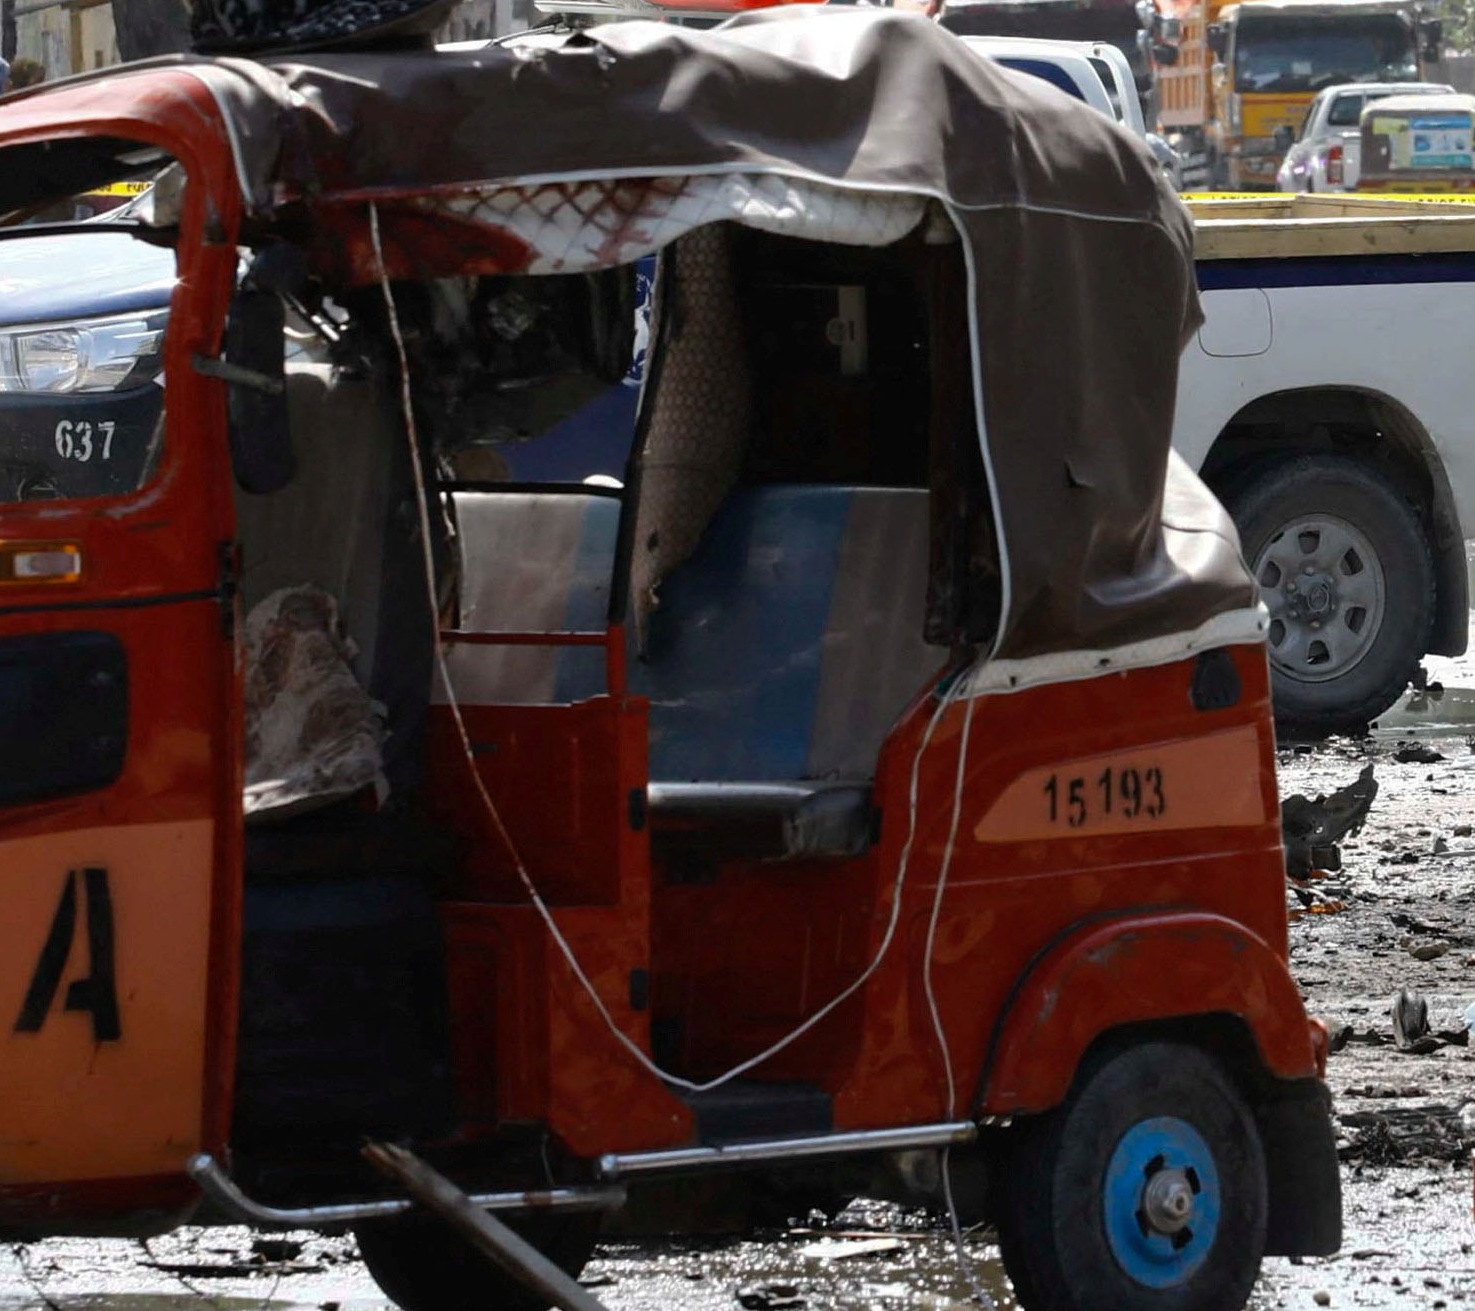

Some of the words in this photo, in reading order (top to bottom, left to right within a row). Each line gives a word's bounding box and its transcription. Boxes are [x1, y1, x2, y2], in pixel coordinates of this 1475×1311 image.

[55, 420, 115, 462] 637
[1042, 766, 1166, 829] 15193
[12, 866, 123, 1043] A
